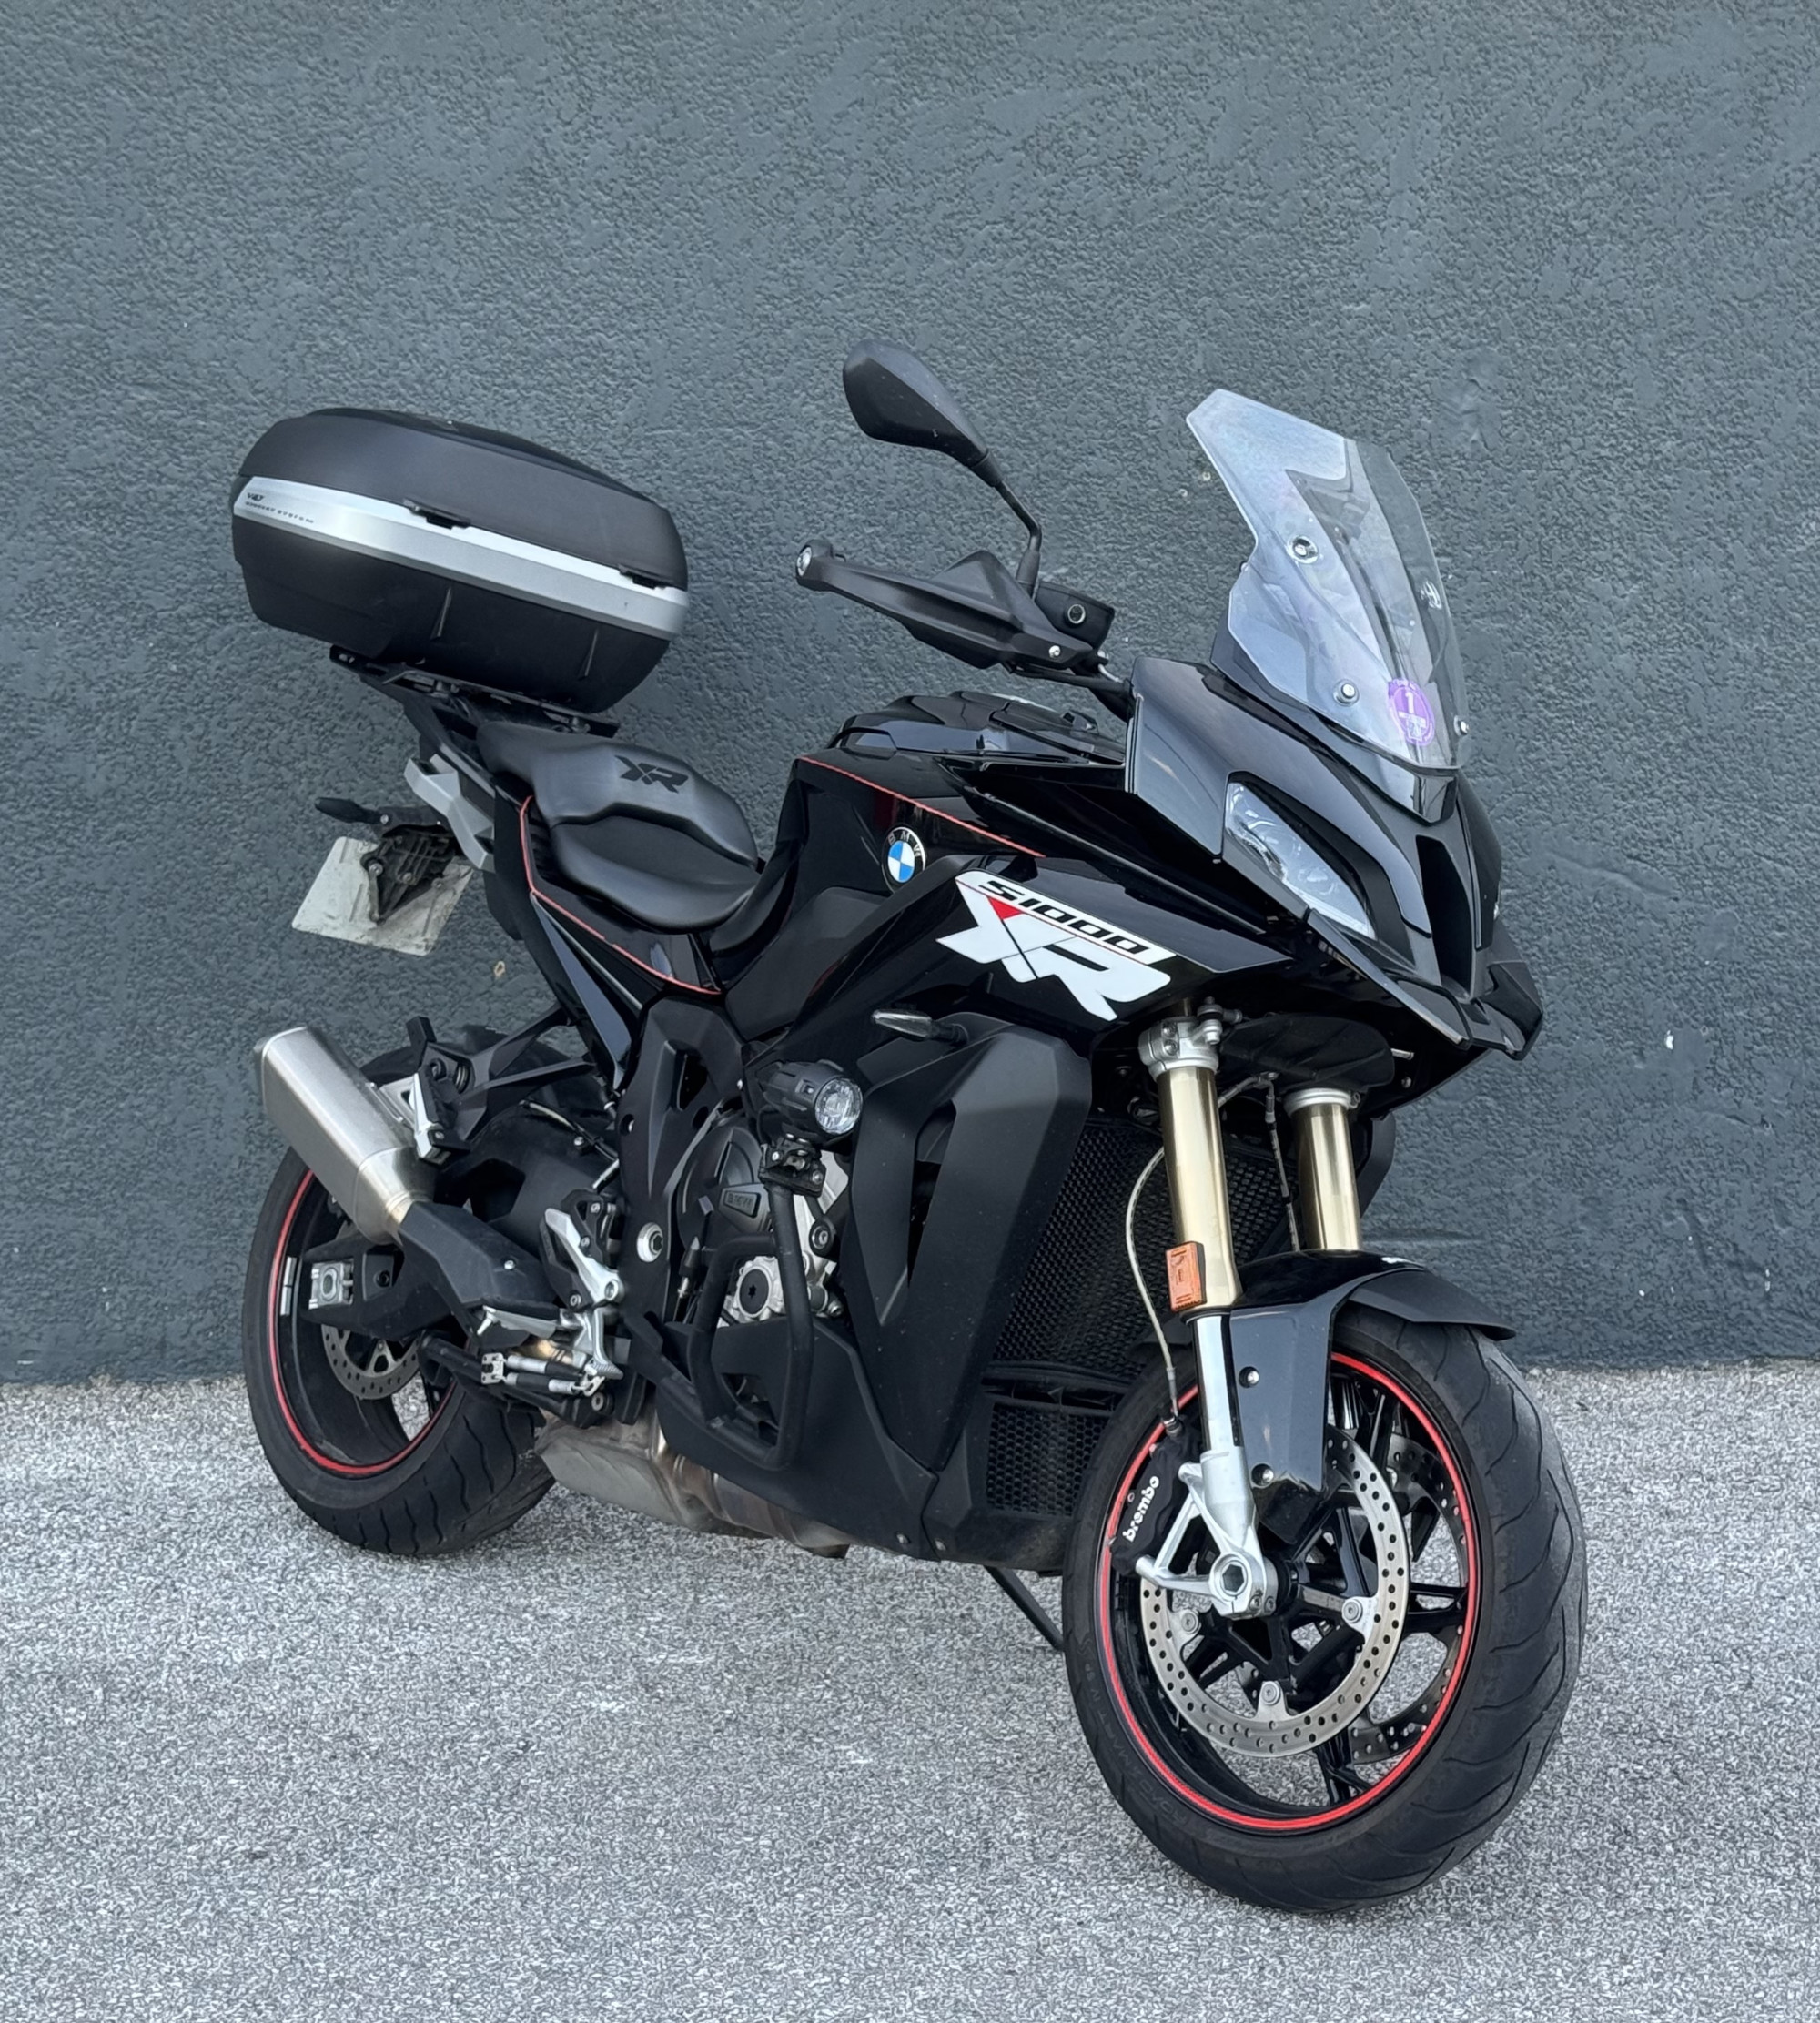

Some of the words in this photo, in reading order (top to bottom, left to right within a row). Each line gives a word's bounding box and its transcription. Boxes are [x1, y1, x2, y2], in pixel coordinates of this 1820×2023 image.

[613, 754, 689, 794] XR
[887, 830, 922, 857] BMW
[935, 879, 1172, 1021] XR
[978, 880, 1150, 956] S1000
[1122, 1475, 1160, 1543] brembo
